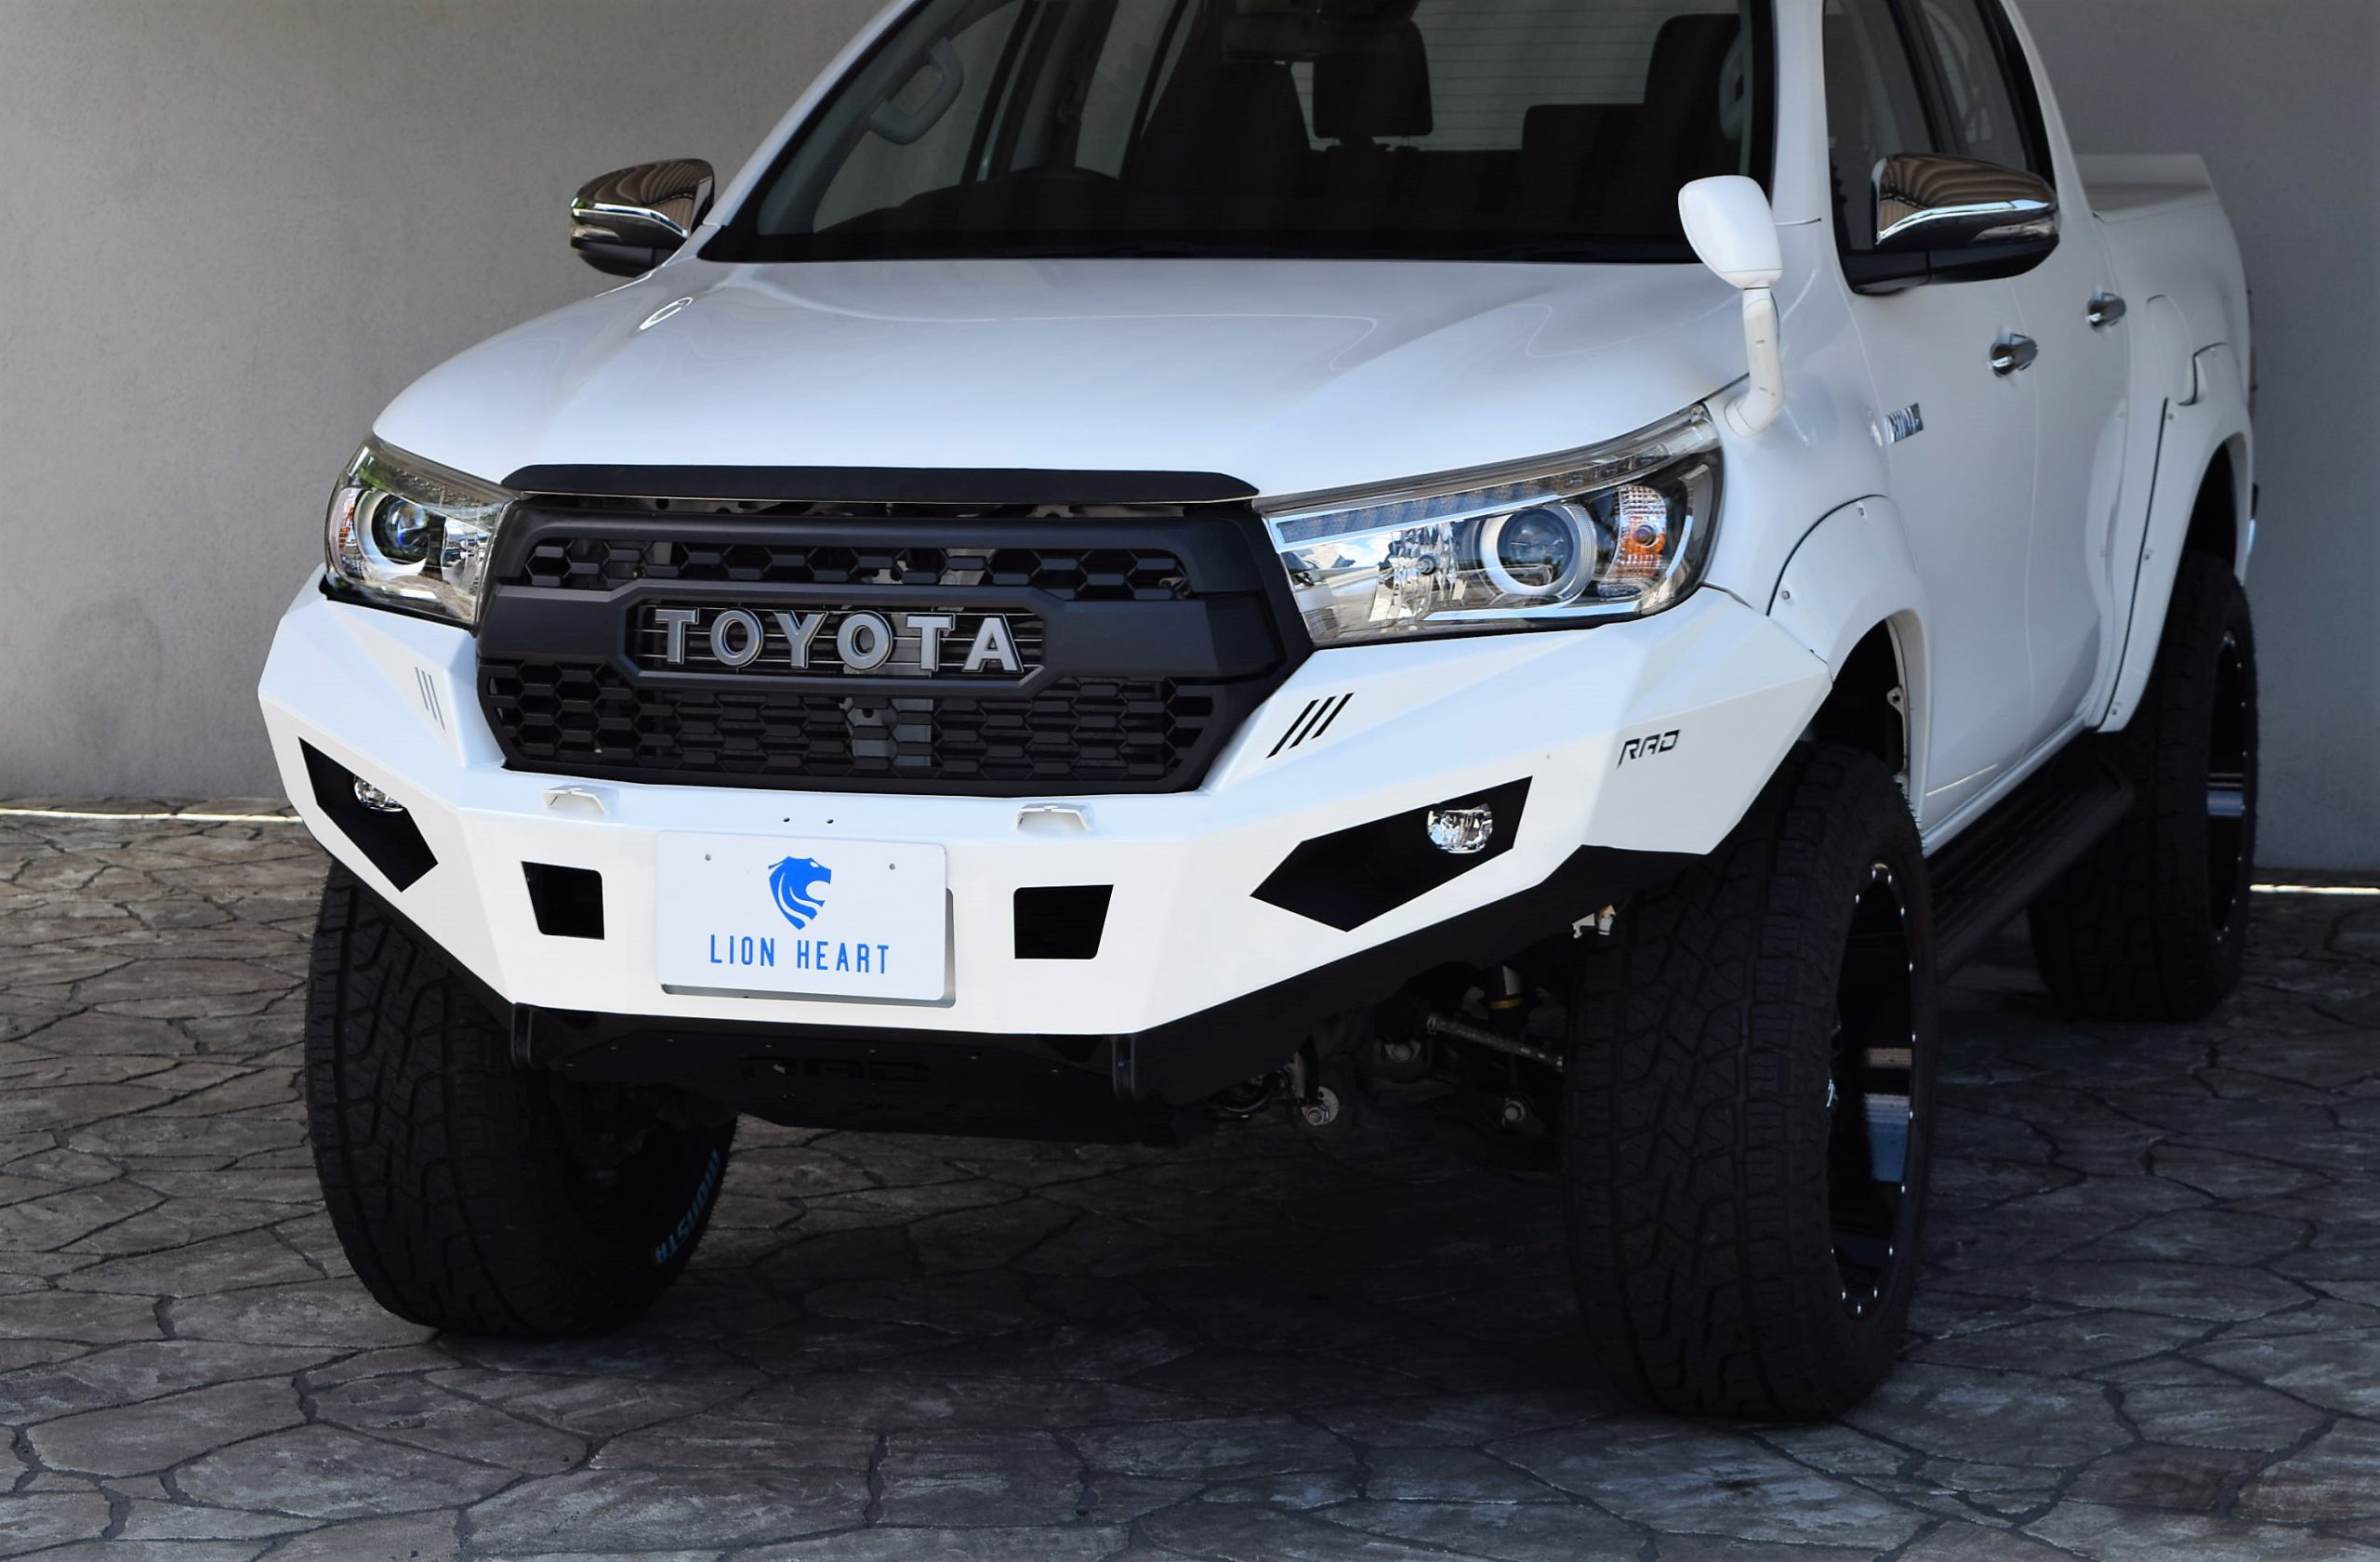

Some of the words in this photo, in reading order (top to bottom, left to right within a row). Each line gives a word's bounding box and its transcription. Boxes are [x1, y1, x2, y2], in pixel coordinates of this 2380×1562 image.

[654, 608, 1025, 674] TOYOTA
[710, 934, 774, 967] LION
[797, 939, 889, 973] HEART
